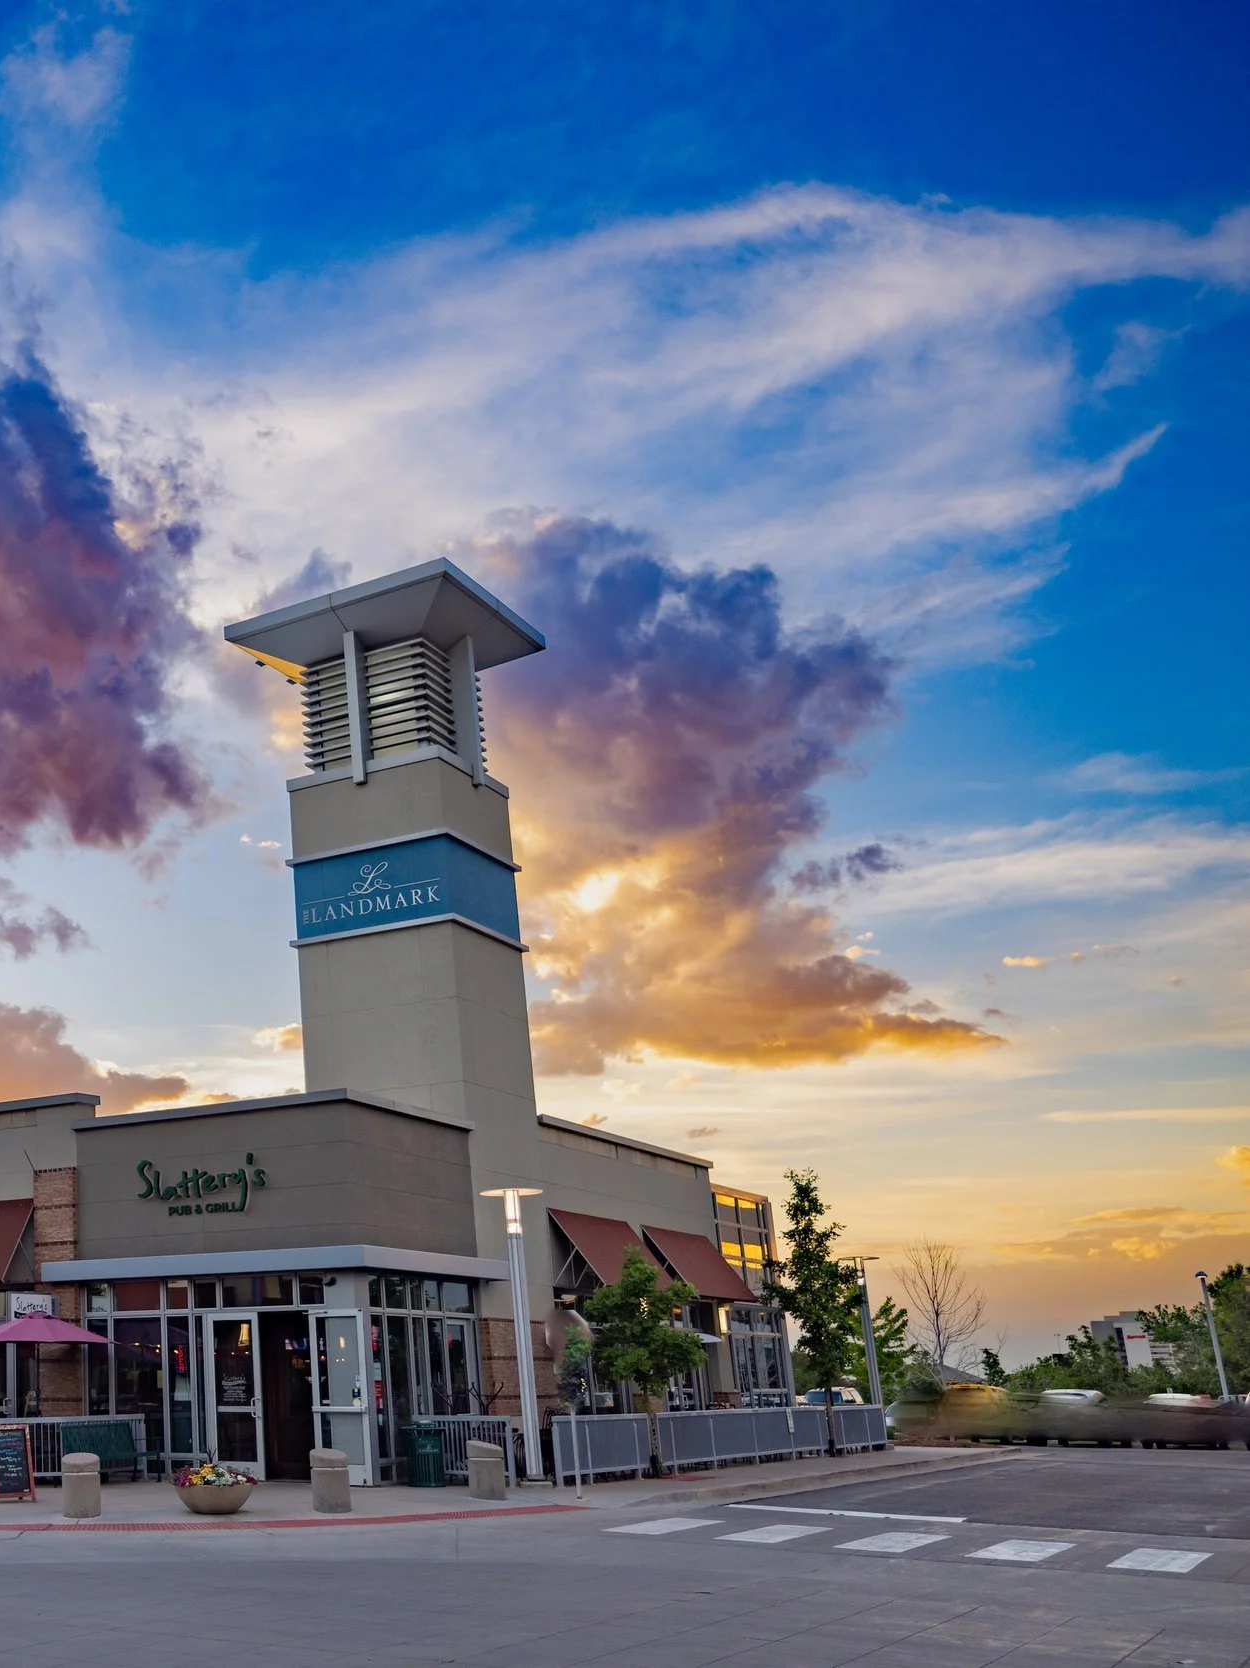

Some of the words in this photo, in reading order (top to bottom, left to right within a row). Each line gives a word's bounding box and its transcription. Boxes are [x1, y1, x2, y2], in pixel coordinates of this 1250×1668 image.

[302, 909, 310, 925] THE
[311, 885, 440, 923] LANDMARK
[137, 1152, 266, 1213] Slattery's
[168, 1205, 192, 1216] PUB
[194, 1203, 203, 1214] &
[205, 1201, 240, 1214] GRILL
[16, 1296, 48, 1312] Slattery's
